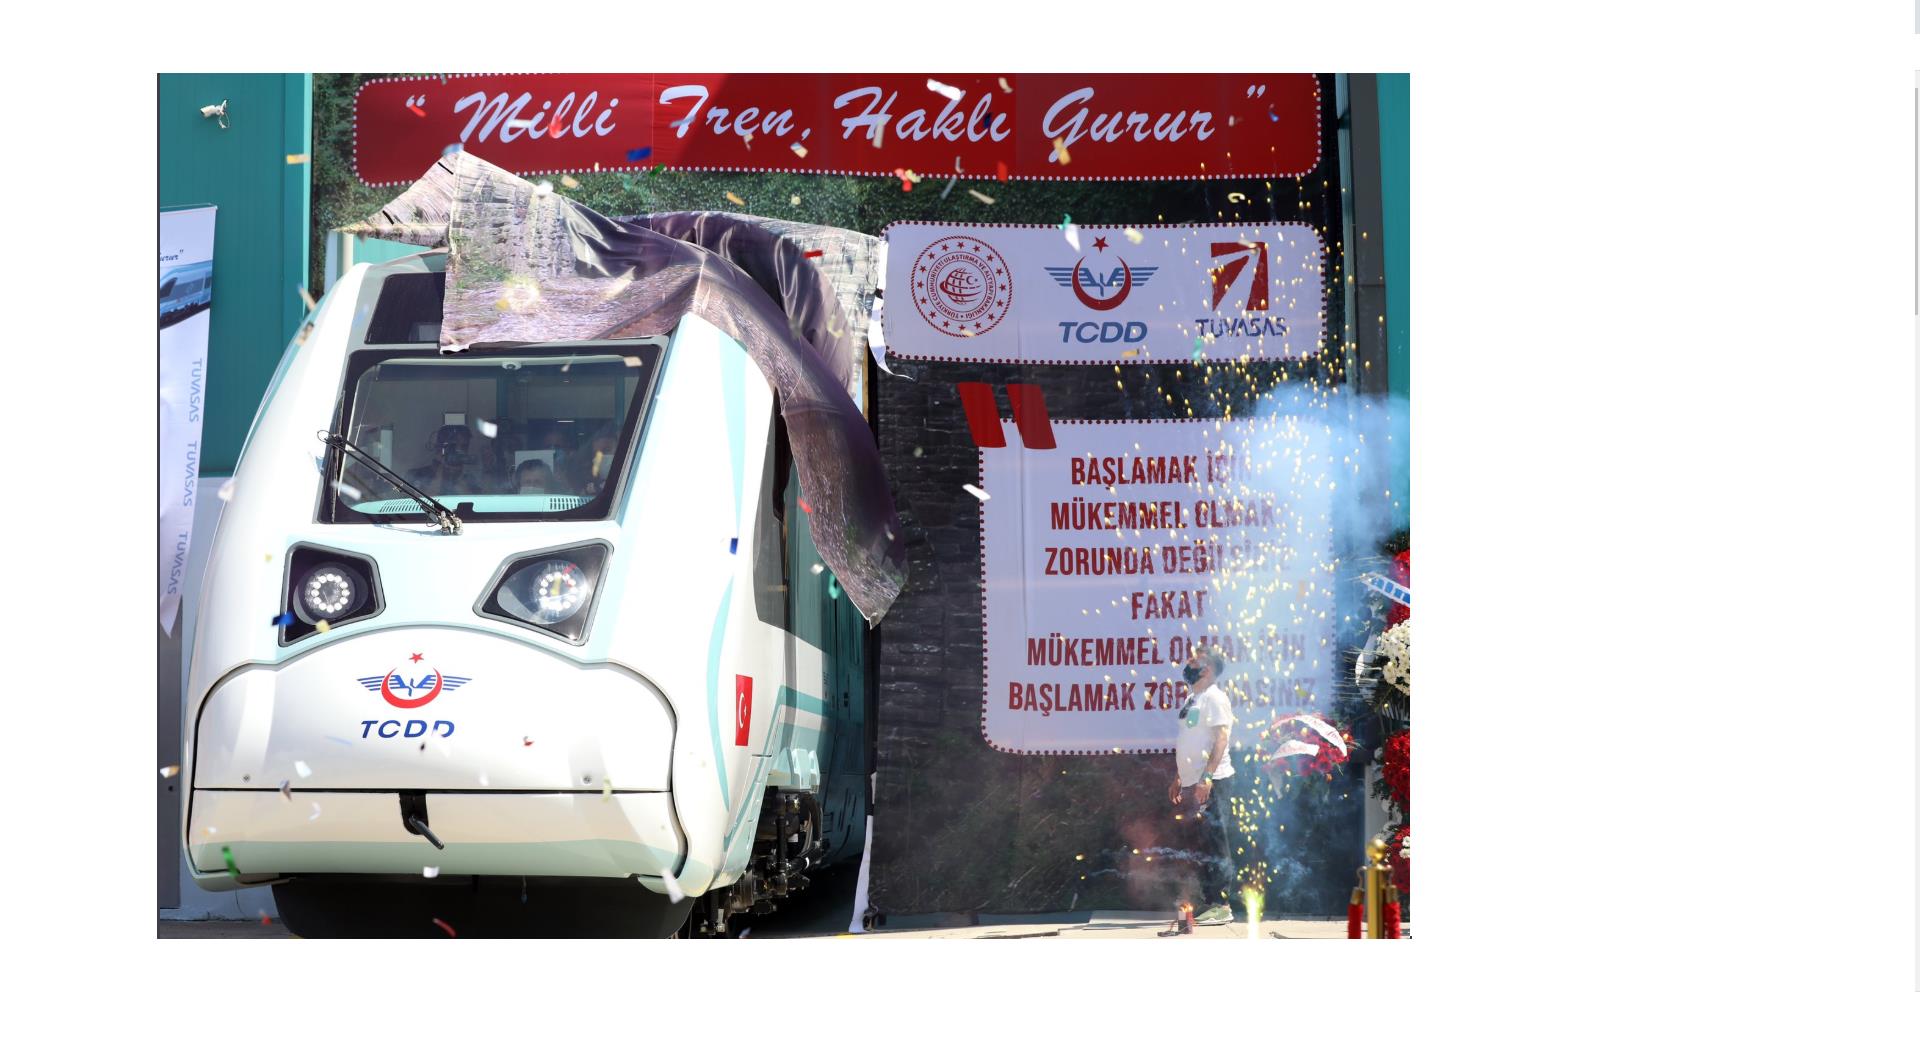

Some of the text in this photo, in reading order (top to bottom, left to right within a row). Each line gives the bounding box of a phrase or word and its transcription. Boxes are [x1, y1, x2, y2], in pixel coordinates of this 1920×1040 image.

[453, 90, 619, 144] Milli
[659, 85, 811, 141] Tren,
[1042, 86, 1215, 163] Gurur
[1058, 321, 1148, 344] TCDD
[1071, 455, 1198, 490] BAŞLAMAK
[1051, 497, 1188, 531] MÜKEMMEL
[1045, 547, 1155, 576] ZORUNDA
[1132, 590, 1207, 620] FAKAT
[1027, 633, 1164, 667] MÜKEMMEL
[1009, 681, 1136, 717] BAŞLAMAK
[361, 719, 455, 739] TCDD
